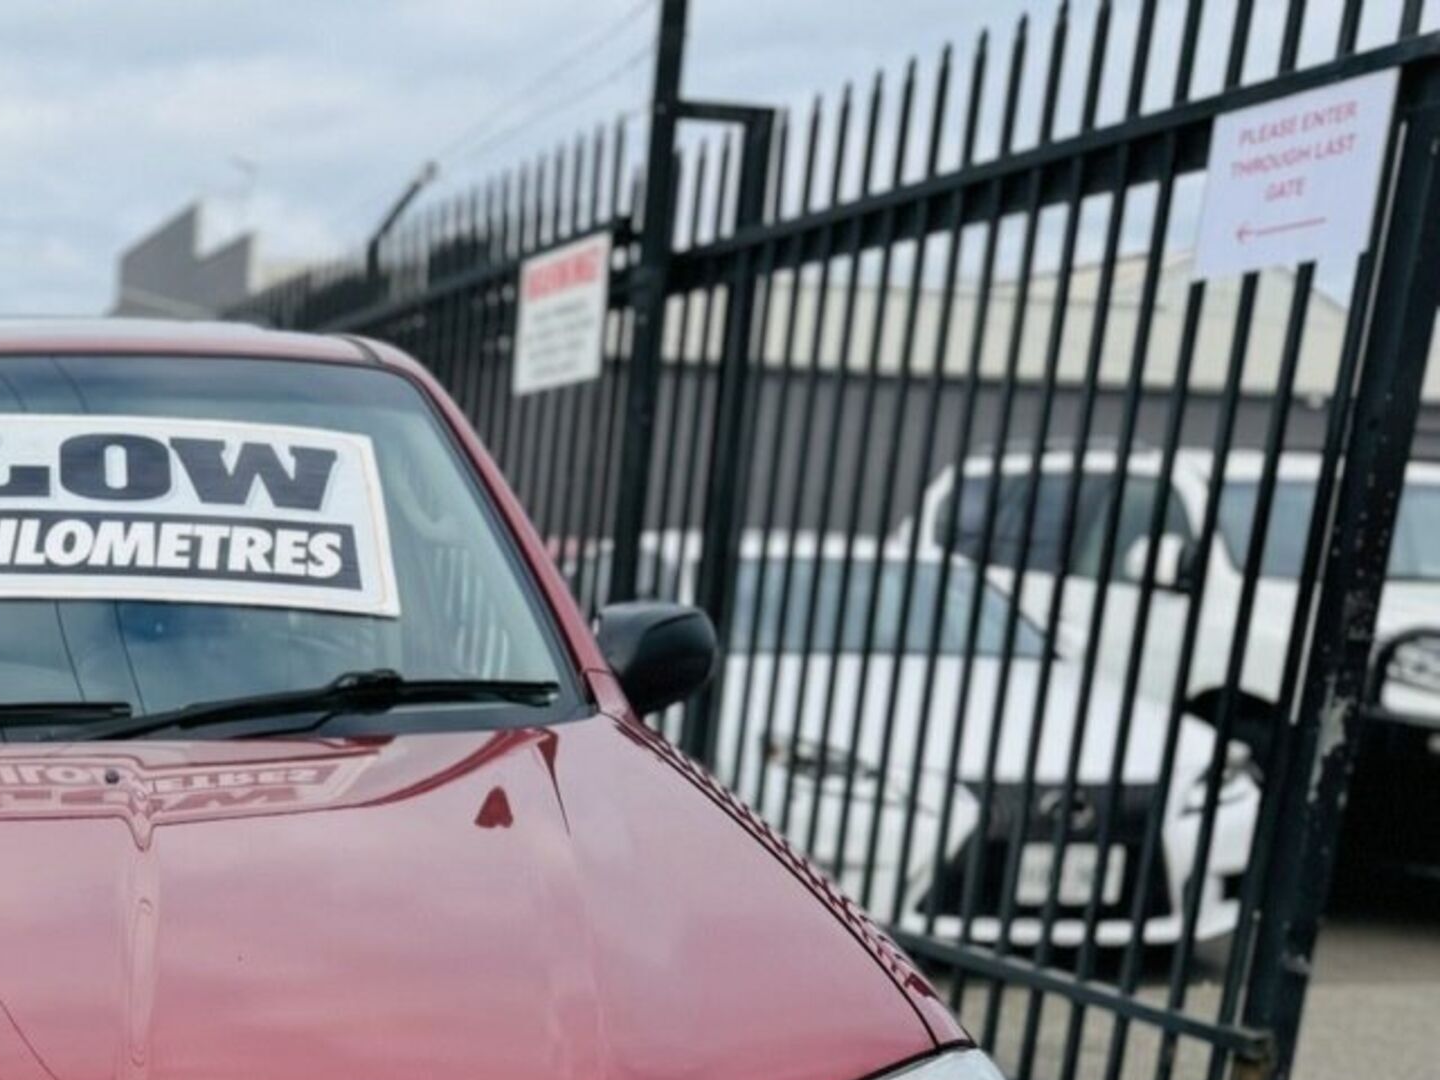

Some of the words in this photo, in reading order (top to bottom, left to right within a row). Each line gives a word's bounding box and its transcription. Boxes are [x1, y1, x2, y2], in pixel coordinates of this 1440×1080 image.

[1238, 116, 1298, 146] PLEASE
[1301, 101, 1357, 131] ENTER
[1231, 147, 1312, 178] THROUGH
[1314, 133, 1356, 161] LAST
[1264, 177, 1305, 202] GATE
